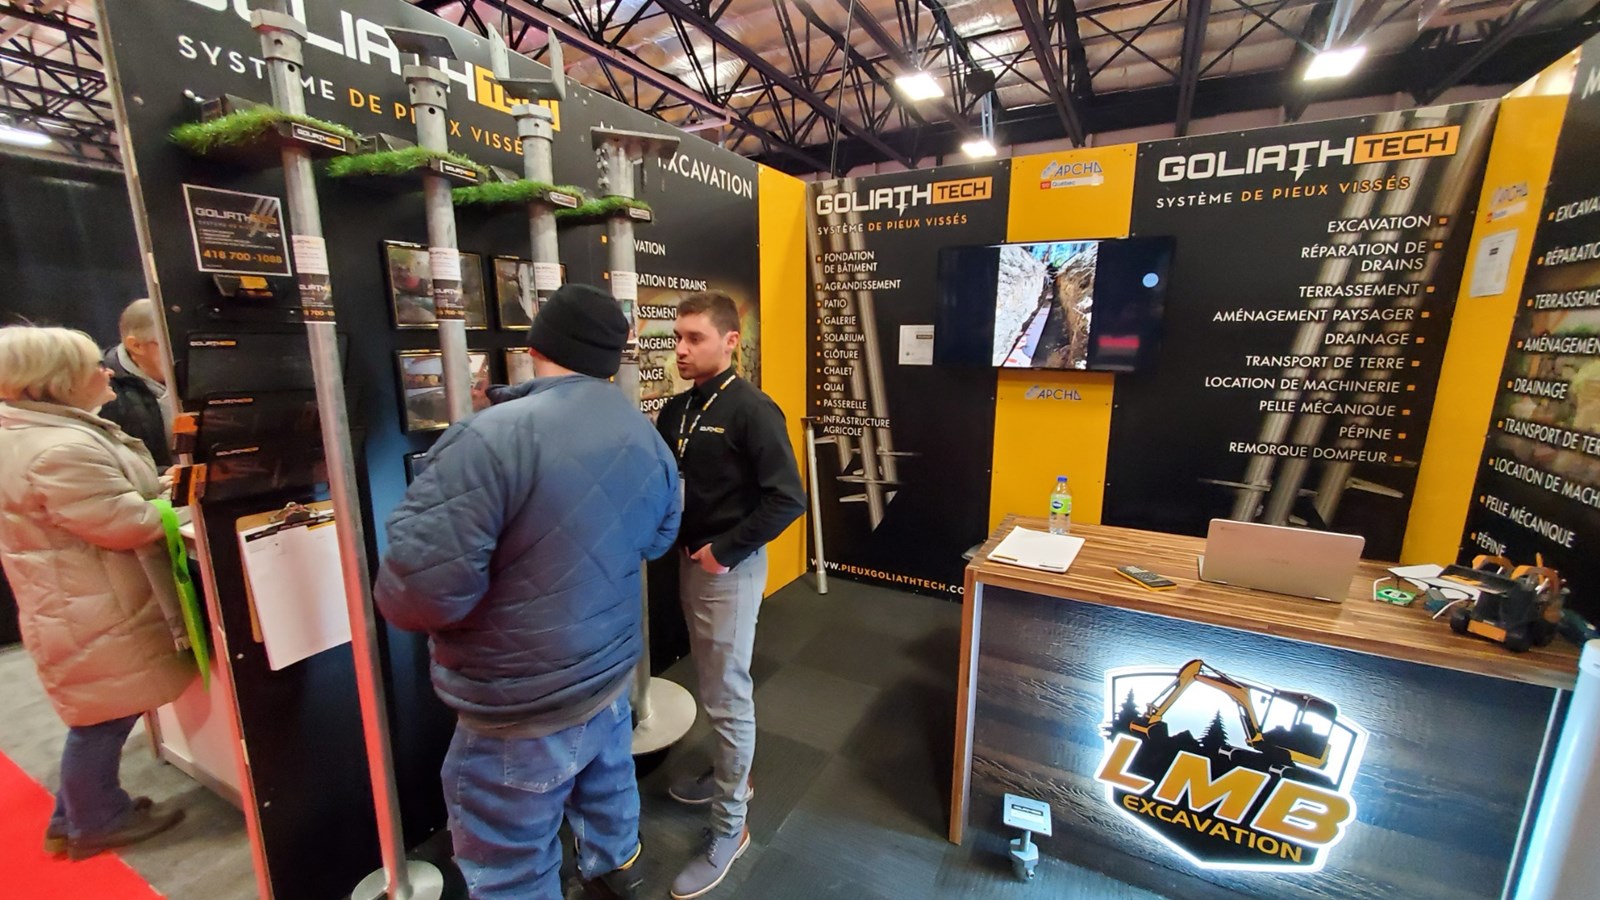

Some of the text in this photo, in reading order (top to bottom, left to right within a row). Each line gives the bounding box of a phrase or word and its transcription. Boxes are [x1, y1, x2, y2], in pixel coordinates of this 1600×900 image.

[178, 35, 523, 156] SYSTME DE PIX VISSÉ
[1156, 176, 1411, 208] SYSTÈME DE PIEUX VISSÉS
[1555, 197, 1600, 222] EXCAVA
[817, 212, 968, 236] SYSTÈME DE PIEUX VISSÉS
[1328, 215, 1432, 233] EXCAVATION
[824, 250, 875, 262] FONDATION
[1301, 241, 1428, 258] RÉPARATION DE
[824, 261, 878, 274] DE BÂTIMENT
[1361, 258, 1424, 272] DRAINS
[668, 277, 678, 288] DE
[680, 278, 706, 292] DRAINS
[824, 280, 901, 291] AGRANDISSEMENT
[1299, 284, 1420, 298] TERRASSEMENT
[824, 299, 846, 308] PATIO
[824, 316, 856, 325] GALERIE
[1212, 308, 1414, 322] AMÉNAGEMENT PAYSAGER
[824, 333, 865, 342] SOLARIUM
[1325, 333, 1410, 345] DRAINAGE
[824, 348, 859, 359] CLÔTURE
[1246, 355, 1404, 370] TRANSPORT DE TERRE
[824, 366, 852, 376] CHALET
[824, 383, 844, 392] QUAI
[1205, 376, 1400, 394] LOCATION DE MACHINERIE
[1514, 378, 1568, 399] DRAINAGE
[824, 399, 867, 410] PASSERELLE
[1259, 400, 1396, 416] PELLE MÉCANIQUE
[824, 415, 890, 428] INFRASTRUCTURE
[824, 426, 862, 436] AGRICOLE
[1339, 425, 1392, 440] PÉPINE
[1504, 418, 1600, 456] TRANSPORT DE TER
[1229, 442, 1388, 463] REMORQUE DOMPEUR
[1494, 457, 1544, 487] LOCATION
[1544, 474, 1560, 492] DE
[1486, 494, 1575, 548] PELLE MÉCANIQUE
[1097, 735, 1352, 846] LMB
[1122, 794, 1303, 863] EXCAVATION
